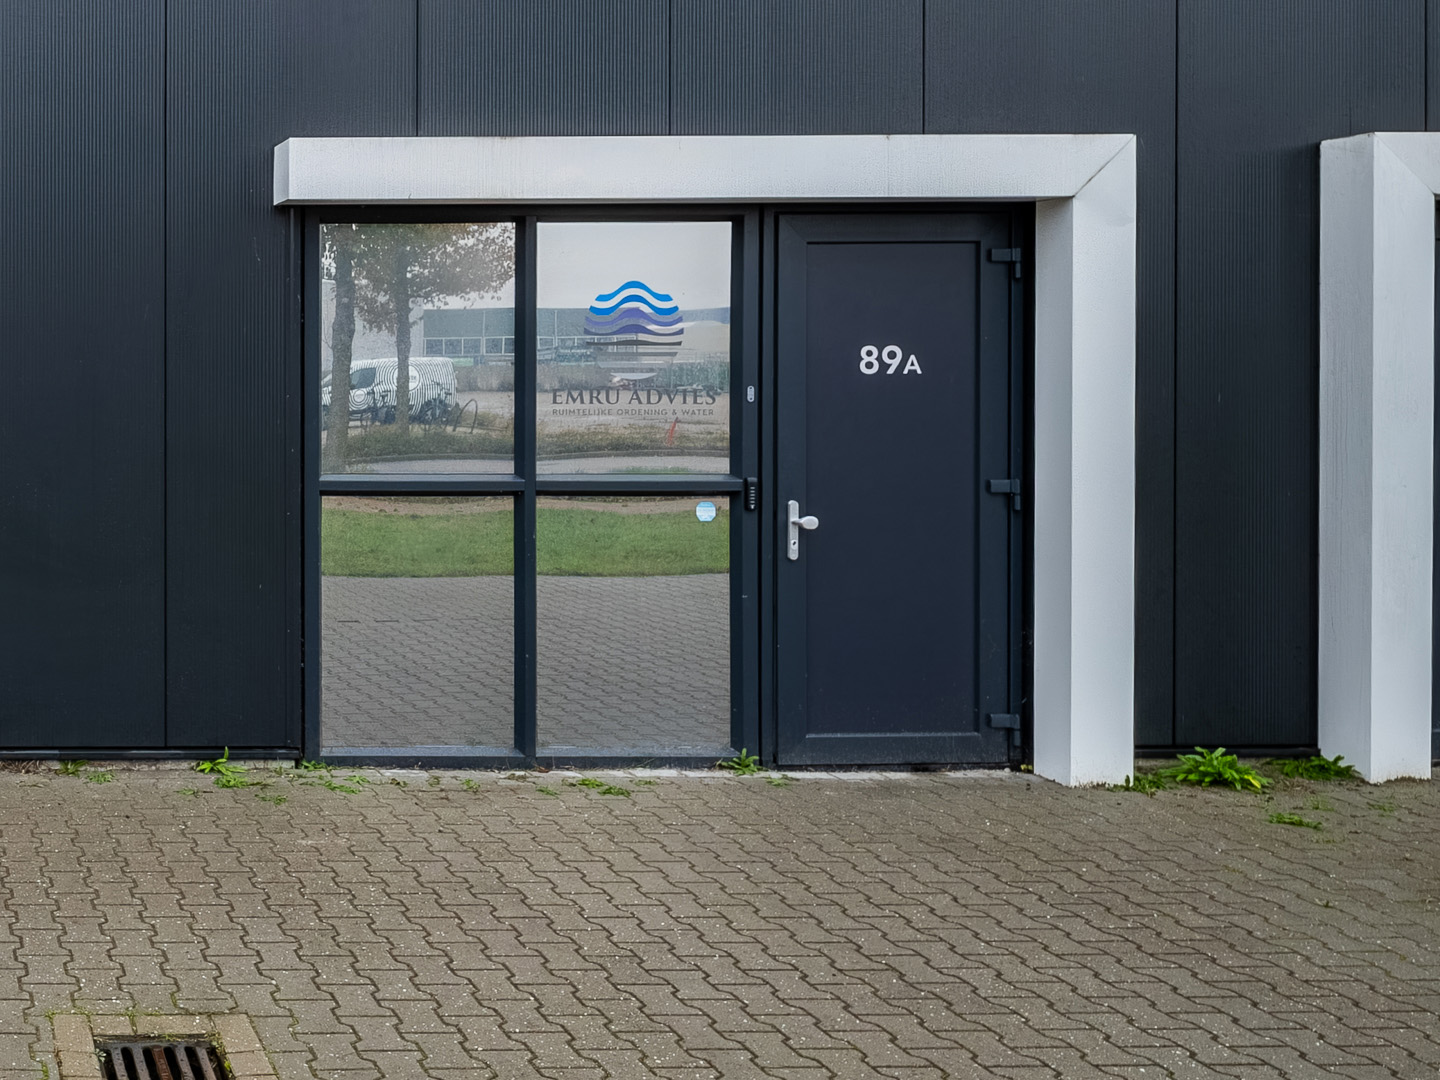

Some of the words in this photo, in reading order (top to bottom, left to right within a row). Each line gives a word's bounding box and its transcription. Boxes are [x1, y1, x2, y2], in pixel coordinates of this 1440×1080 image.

[859, 345, 922, 375] 89A
[551, 388, 621, 405] EMRU
[627, 388, 717, 406] ADVIES
[552, 408, 613, 416] RUIMTELIJKE
[616, 408, 668, 416] ORDENING
[671, 408, 678, 416] &
[681, 408, 714, 416] WATER
